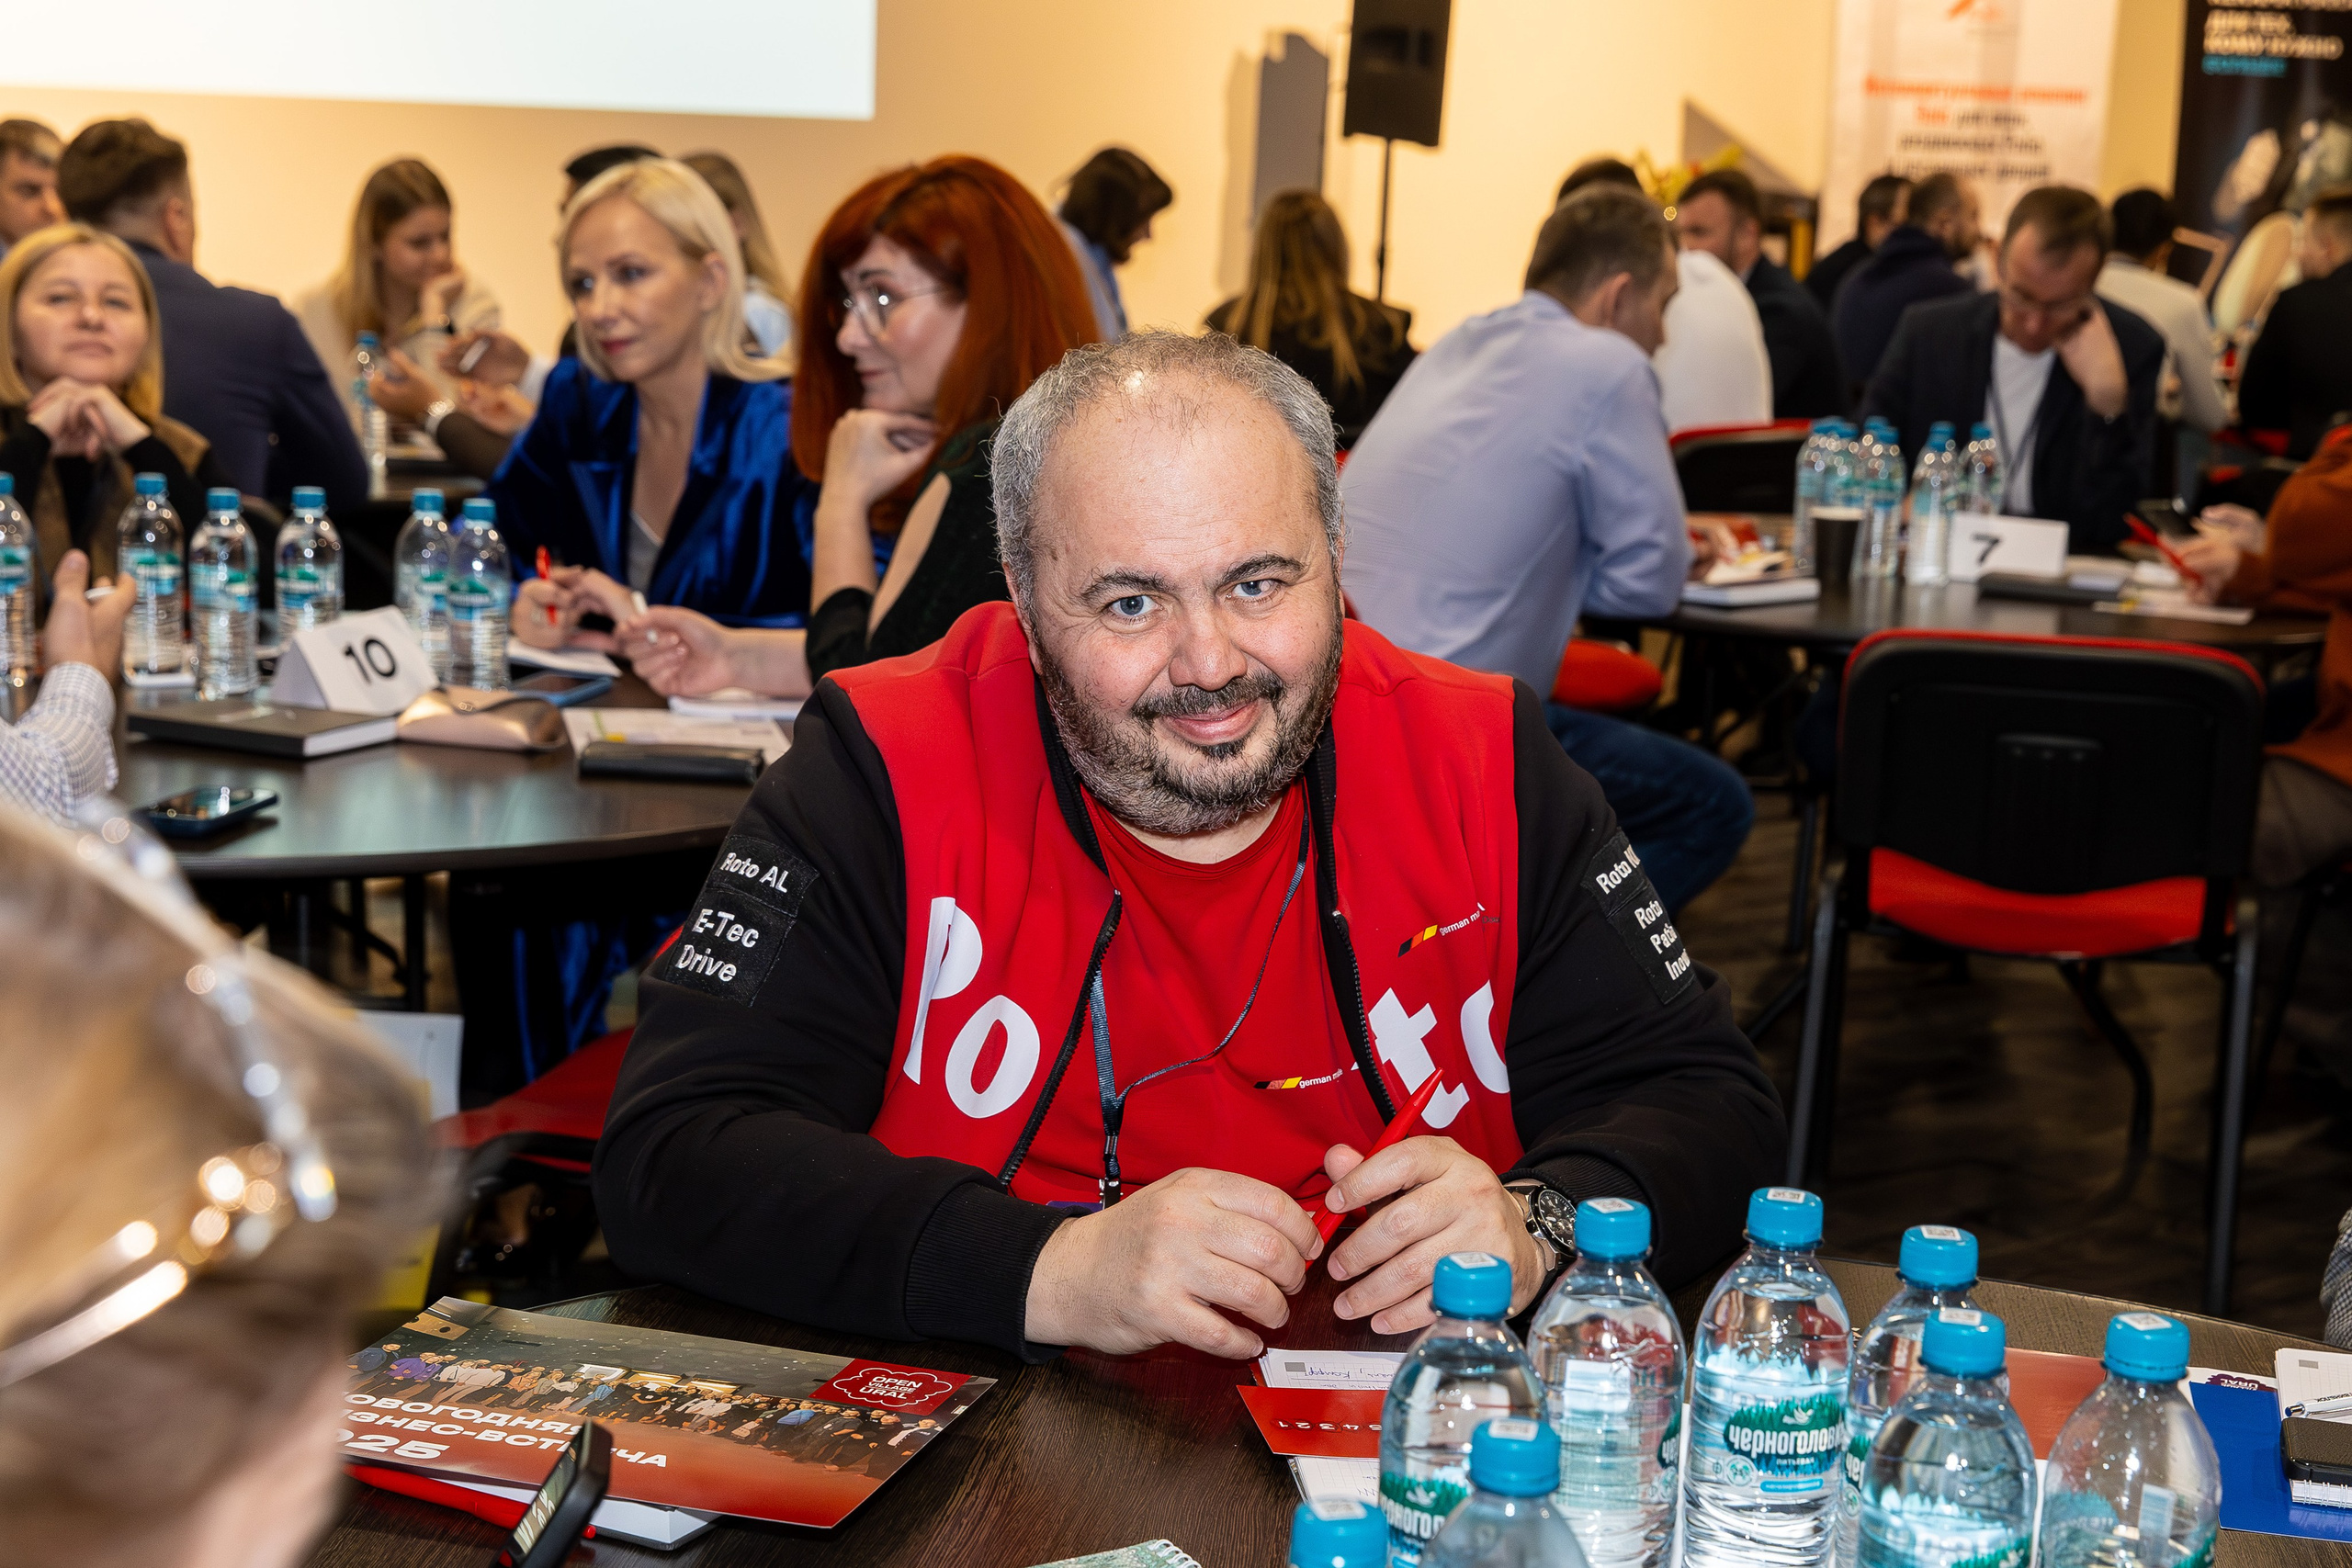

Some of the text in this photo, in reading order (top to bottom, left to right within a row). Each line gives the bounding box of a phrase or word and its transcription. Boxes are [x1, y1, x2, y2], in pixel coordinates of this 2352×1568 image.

[1971, 533, 2001, 566] 7
[345, 638, 396, 683] 10
[719, 852, 789, 893] Roto AL
[1596, 860, 1633, 895] Roto
[691, 908, 759, 948] E-Tec
[1439, 918, 1470, 937] german
[675, 944, 737, 982] Drive
[1298, 1075, 1332, 1089] german
[859, 1387, 908, 1400] URAL
[868, 1382, 916, 1393] VILLAGE
[872, 1376, 922, 1389] OPEN
